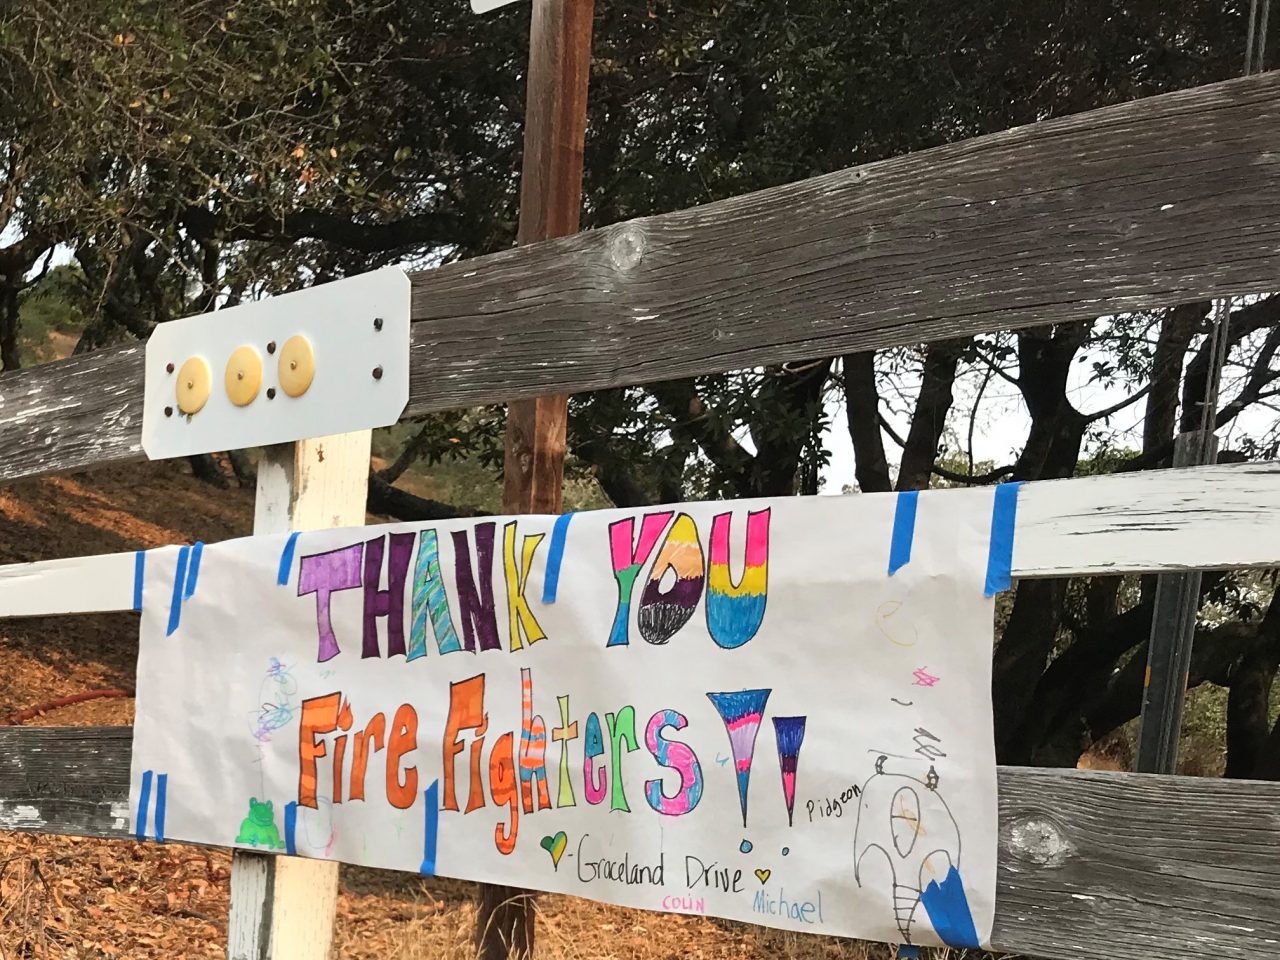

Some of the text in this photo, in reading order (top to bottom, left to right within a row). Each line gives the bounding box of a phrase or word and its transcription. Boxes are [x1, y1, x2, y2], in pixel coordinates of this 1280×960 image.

[297, 505, 772, 663] THANK YOU
[297, 690, 419, 812] Fire
[805, 784, 862, 823] Pidgeon
[685, 854, 745, 893] Drive
[752, 887, 824, 924] Michael
